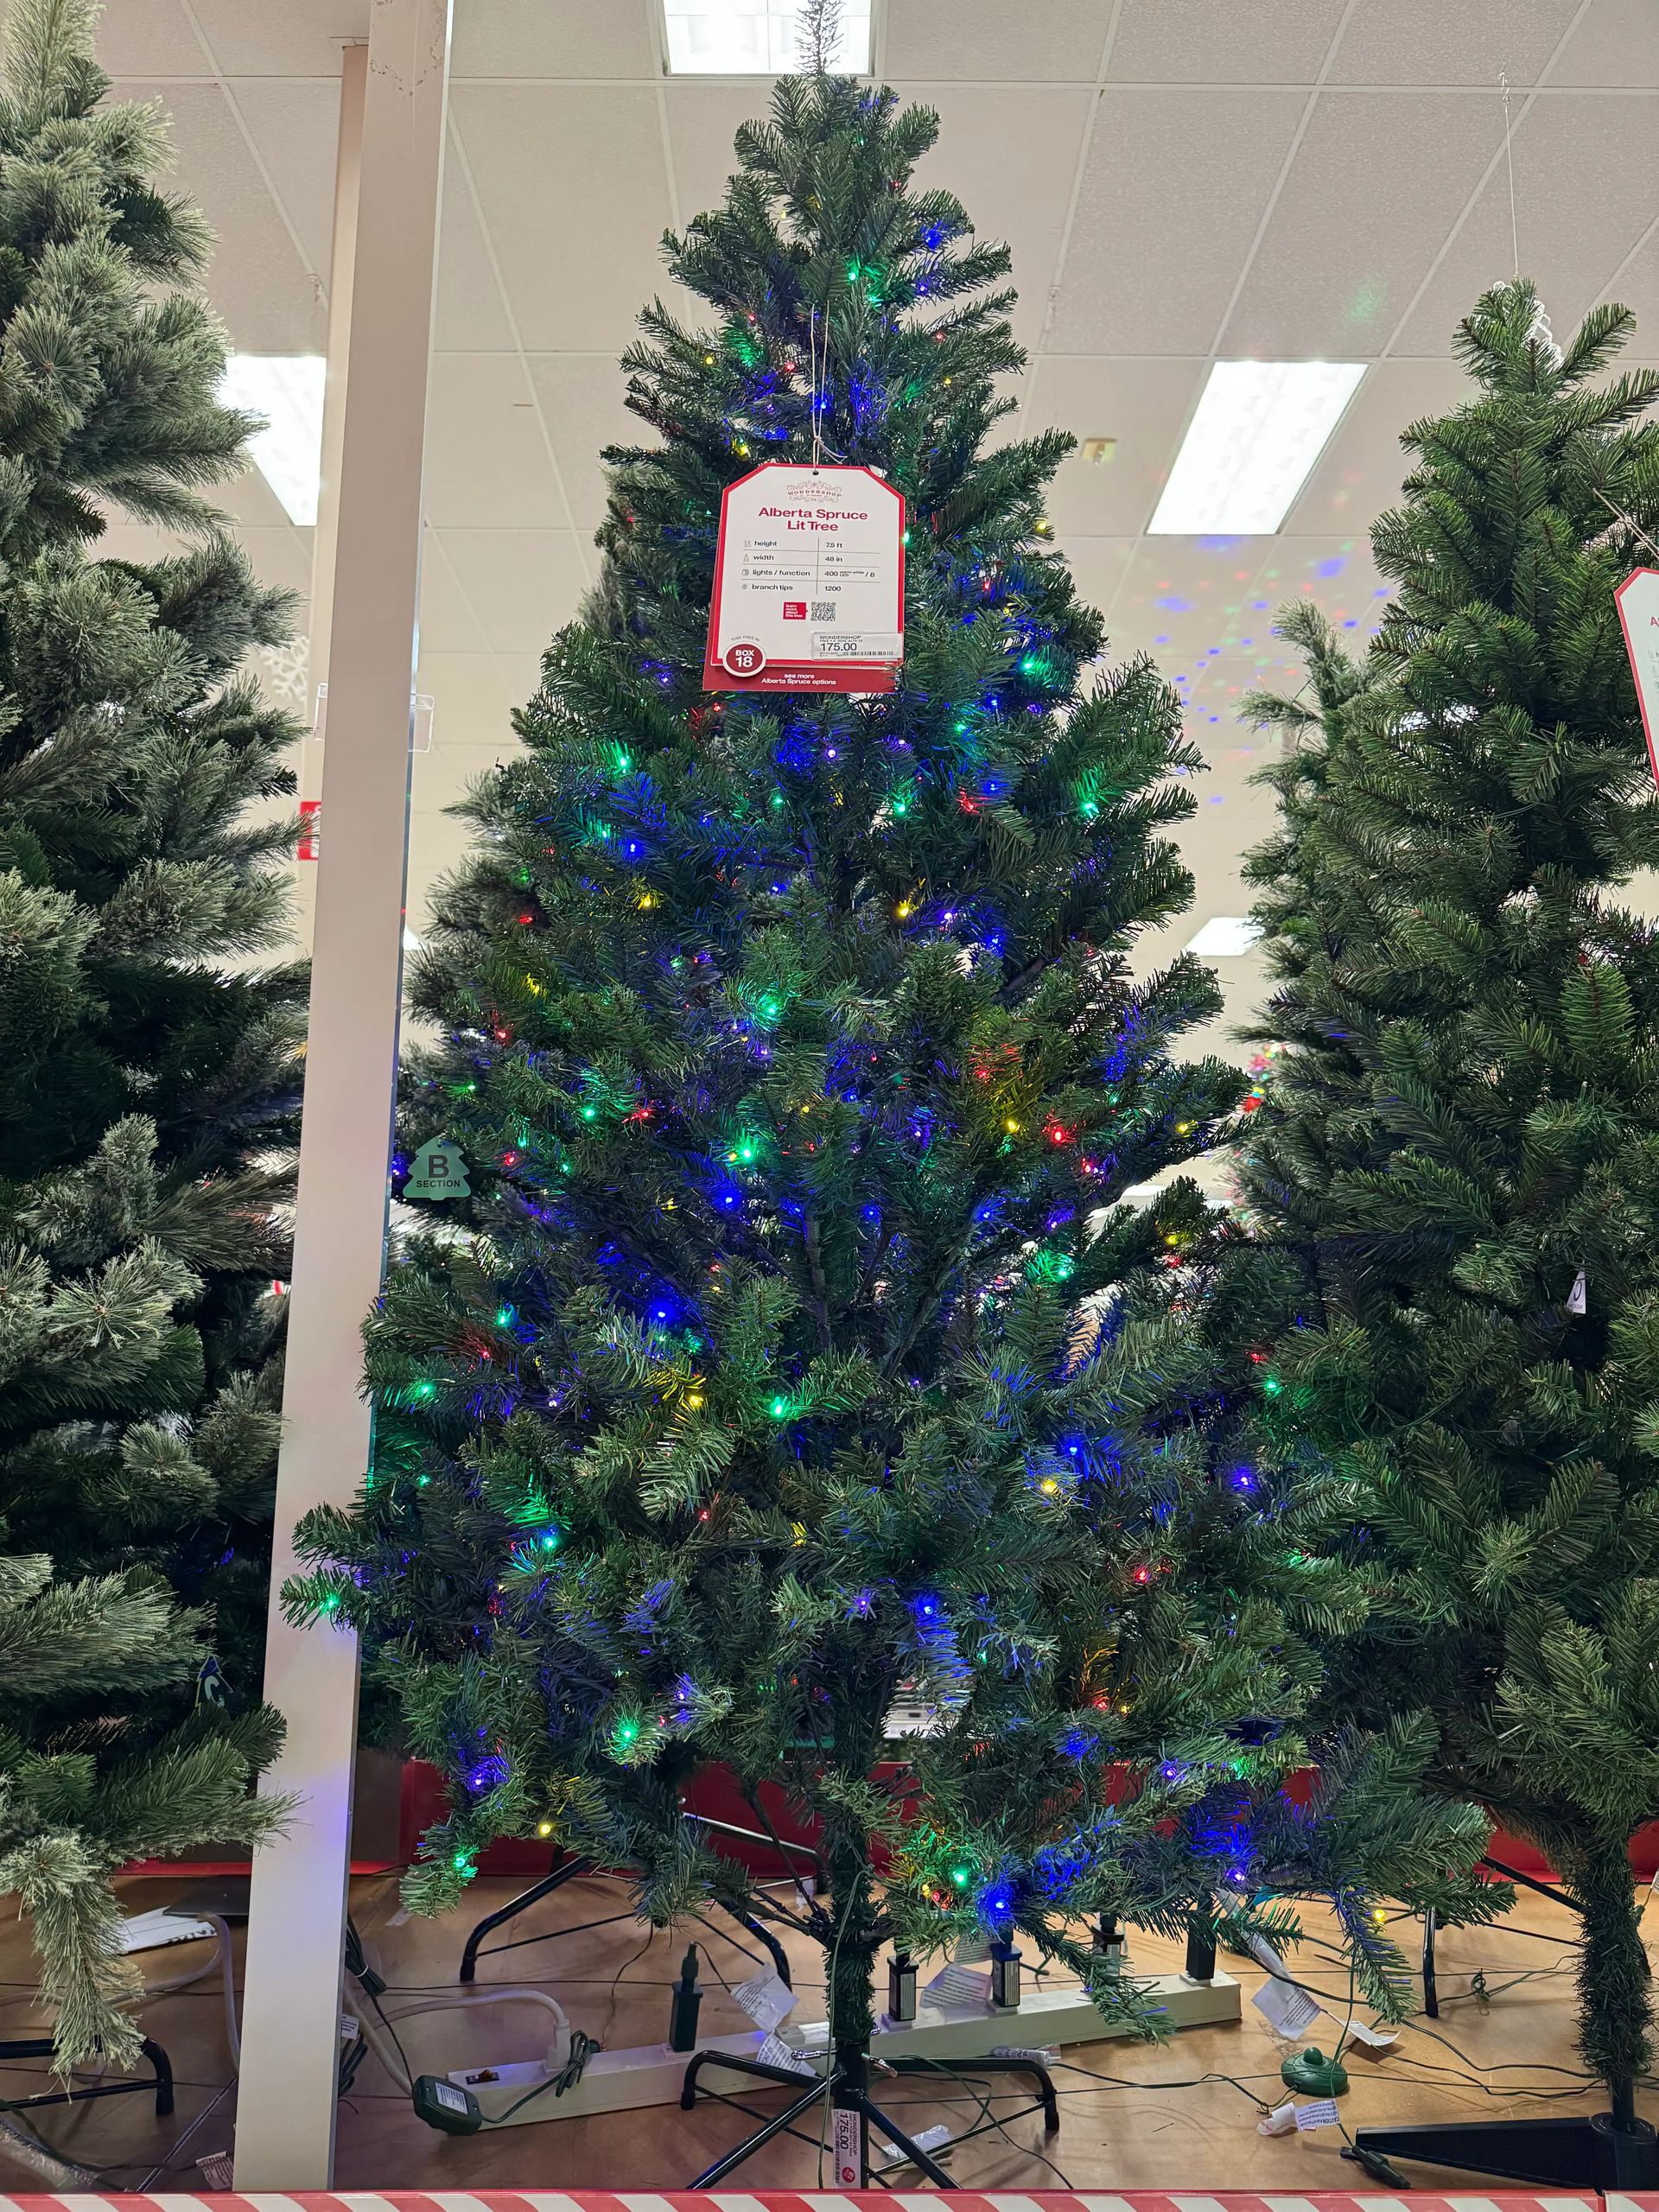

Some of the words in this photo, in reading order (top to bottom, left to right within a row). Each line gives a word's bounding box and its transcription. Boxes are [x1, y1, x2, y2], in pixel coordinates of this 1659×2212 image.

[787, 488, 842, 498] WONDERSHOP
[758, 507, 812, 518] Alberta
[816, 509, 868, 520] Spruce
[787, 520, 805, 531] Lit
[808, 521, 839, 531] Tree
[753, 569, 773, 578] lights
[779, 583, 793, 592] tips
[820, 643, 857, 652] 175.00
[735, 657, 753, 668] 18
[429, 1154, 449, 1178] B
[416, 1179, 461, 1188] SECTION
[840, 2113, 849, 2150] 175.00
